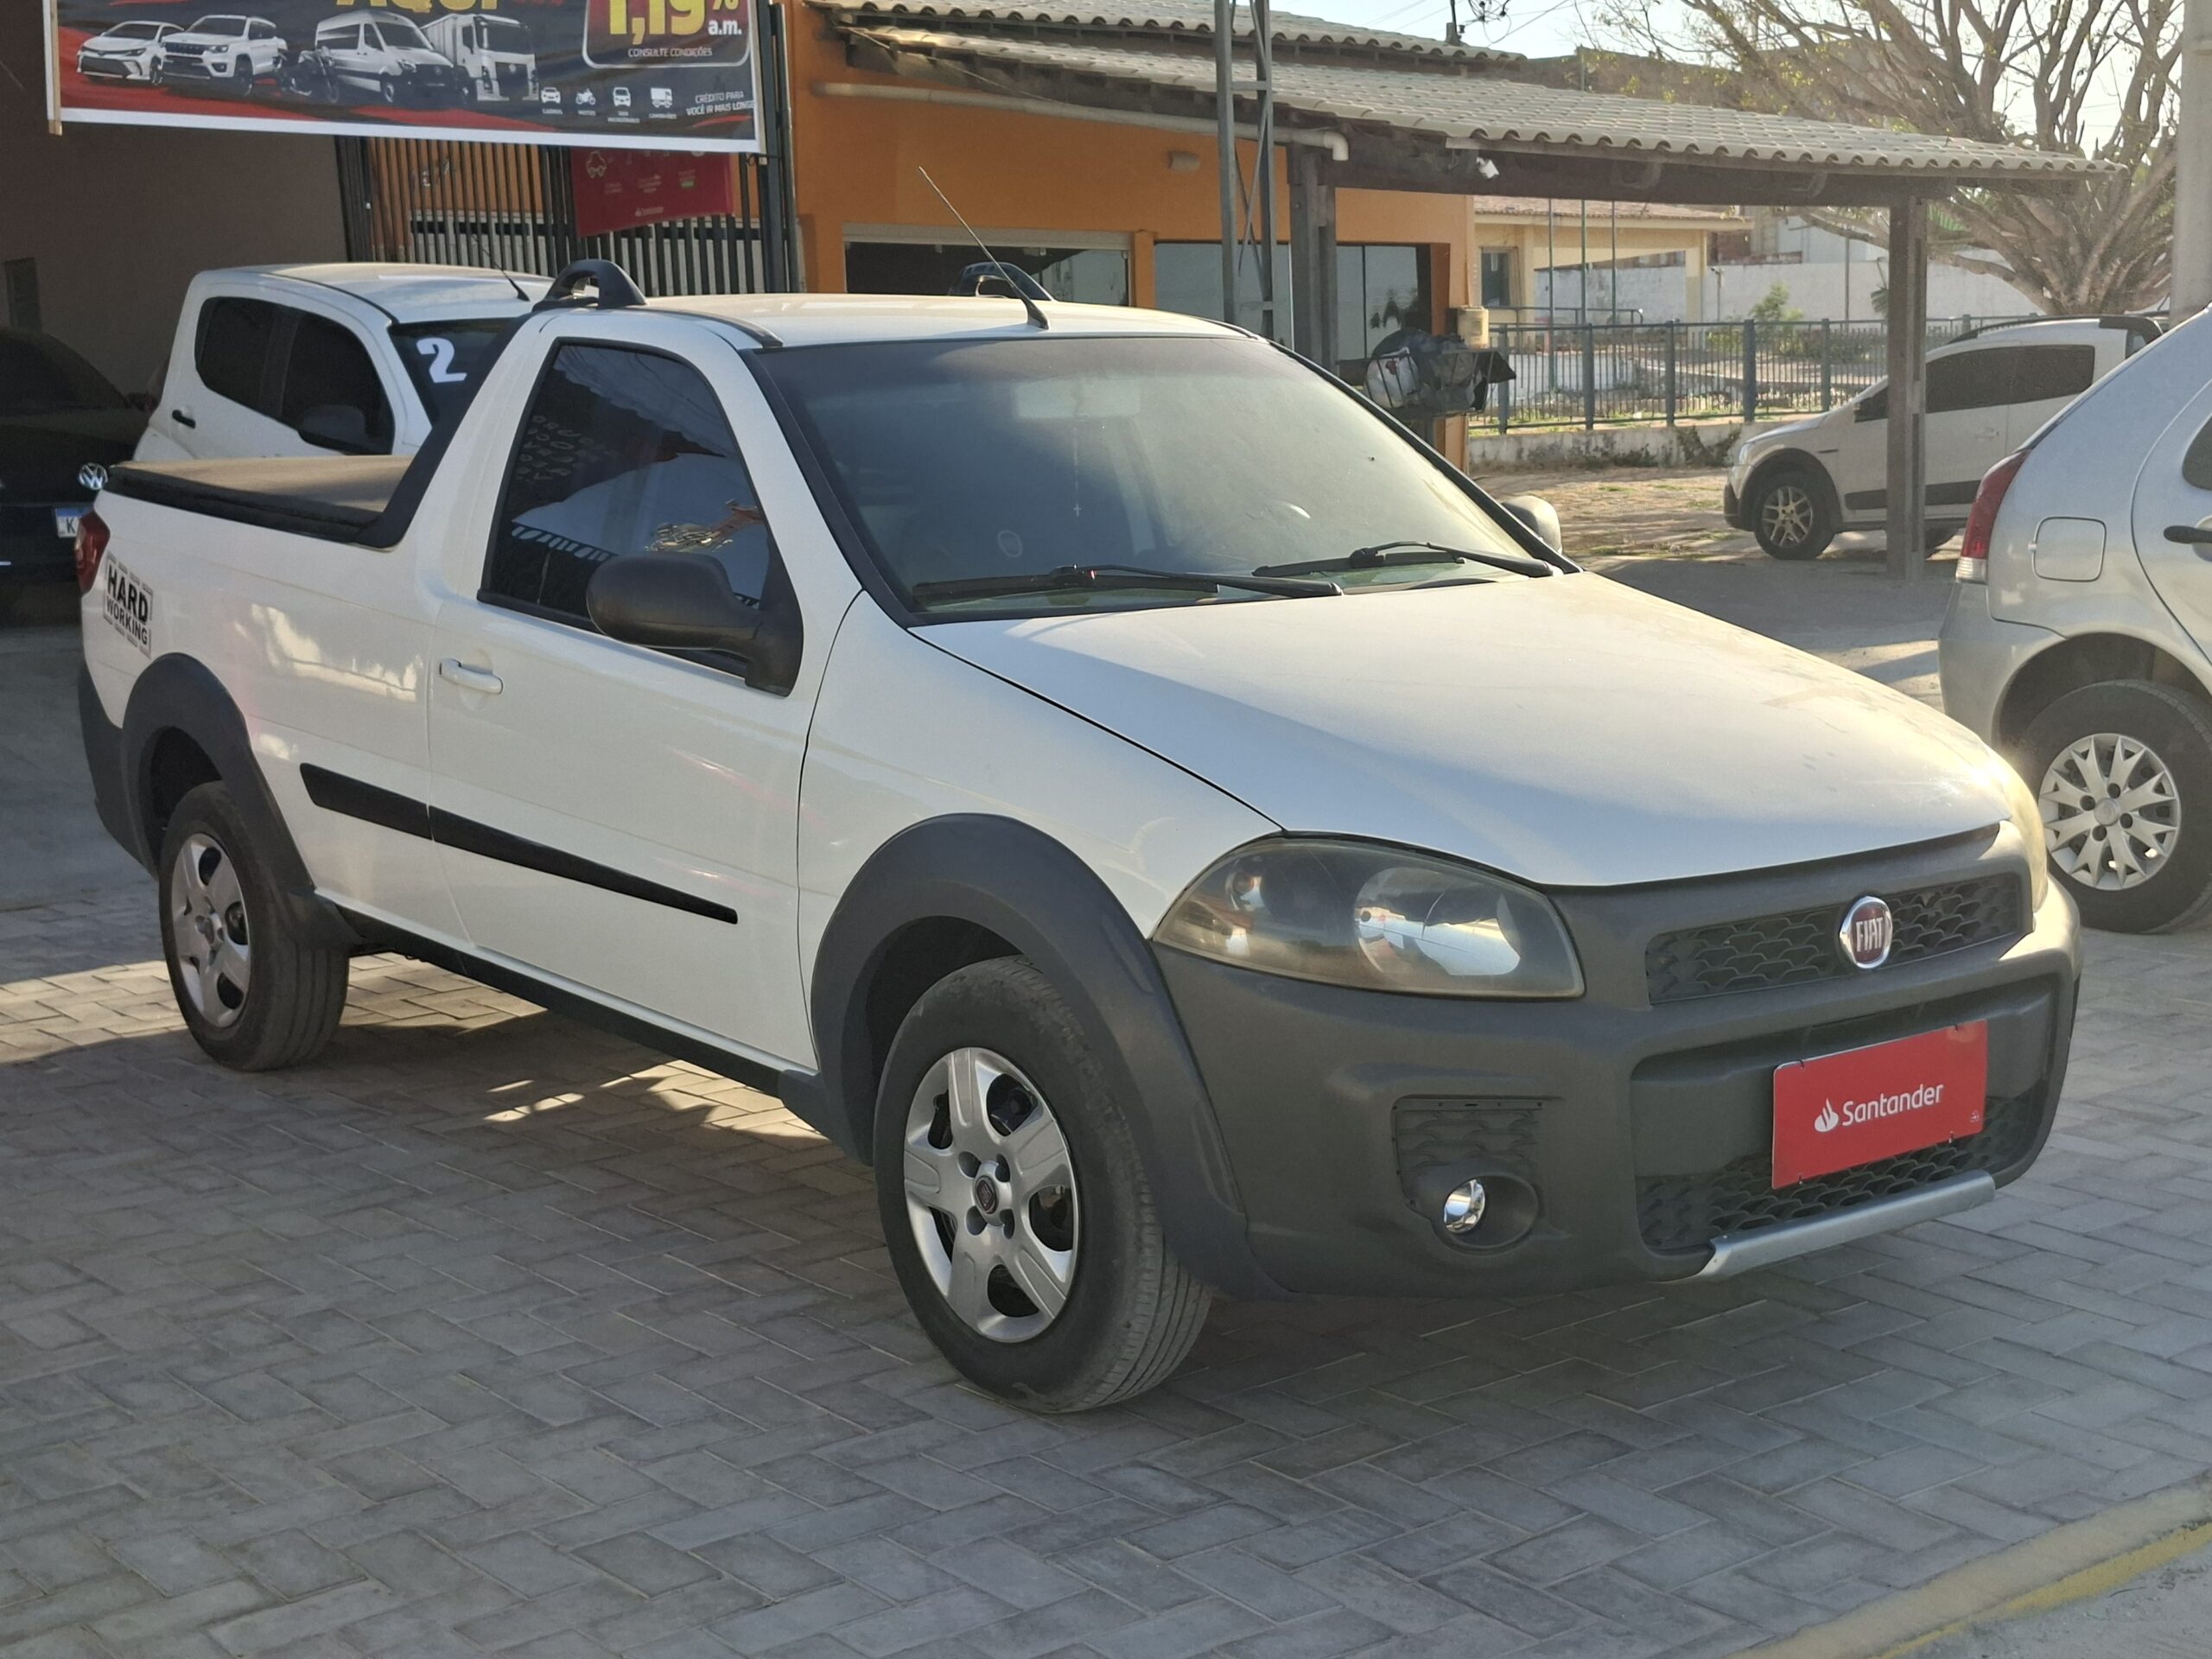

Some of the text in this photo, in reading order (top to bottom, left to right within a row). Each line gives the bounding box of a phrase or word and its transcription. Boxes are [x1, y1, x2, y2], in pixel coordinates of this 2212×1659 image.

[708, 19, 742, 35] a.m.
[627, 48, 669, 58] CONSULTE
[416, 337, 467, 384] 2
[107, 564, 149, 625] HARD
[106, 594, 148, 645] WORKING
[1855, 917, 1884, 952] FIAT
[1842, 1084, 1944, 1127] Santander
